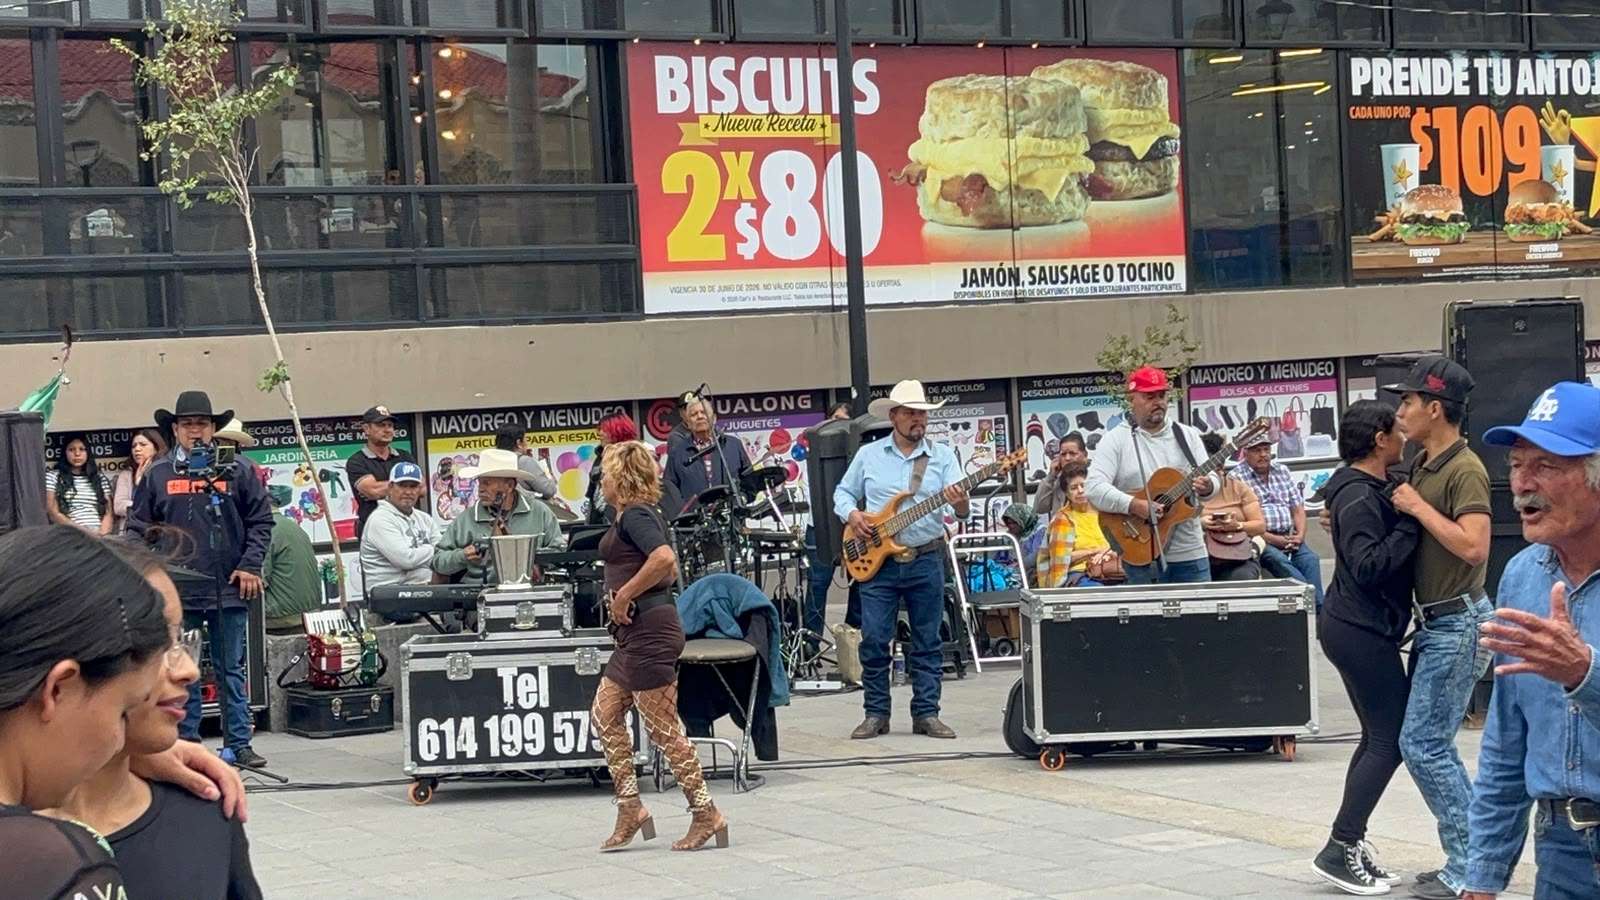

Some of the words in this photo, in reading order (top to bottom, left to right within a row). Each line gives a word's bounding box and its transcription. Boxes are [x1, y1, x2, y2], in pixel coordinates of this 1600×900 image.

[1350, 57, 1470, 96] PRENDE
[1474, 58, 1511, 96] TU
[655, 55, 881, 115] BISCUITS
[1349, 106, 1373, 119] CADA
[1374, 106, 1393, 119] UNO
[1393, 105, 1411, 118] POR
[713, 112, 764, 133] Nueva
[766, 113, 817, 132] Receta
[1410, 104, 1542, 198] $109
[734, 150, 884, 261] $80
[961, 262, 1025, 288] JAMÓN,
[1028, 264, 1100, 286] SAUSAGE
[1103, 263, 1114, 283] O
[1117, 262, 1175, 282] TOCINO
[669, 285, 697, 294] VIGENCIA
[809, 281, 828, 289] OTRAS
[953, 291, 991, 299] DISPONIBLES
[1037, 287, 1070, 296] DESAYUNOS
[1090, 285, 1098, 293] EN
[1099, 284, 1139, 292] RESTAURANTES
[1190, 364, 1254, 386] MAYOREO
[1257, 364, 1267, 380] Y
[1271, 361, 1335, 379] MENUDEO
[928, 385, 940, 394] DE
[1033, 380, 1042, 388] TE
[1044, 376, 1092, 387] OFRECEMOS
[1258, 382, 1310, 395] CALCETINES
[933, 394, 960, 402] BAOS
[1022, 386, 1070, 398] DESCUENTO
[1071, 386, 1082, 394] EN
[718, 395, 812, 414] UALONG
[927, 407, 985, 418] ACCESORIOS
[314, 422, 332, 432] 5%
[334, 420, 348, 430] AL
[431, 412, 518, 435] MAYOREO
[523, 411, 535, 428] Y
[727, 419, 781, 431] JUGUETES
[262, 437, 278, 446] EN
[338, 431, 353, 441] DE
[455, 438, 496, 449] ARTÍCU
[497, 665, 550, 710] Tel
[418, 716, 478, 762] 614
[484, 712, 546, 757] 199
